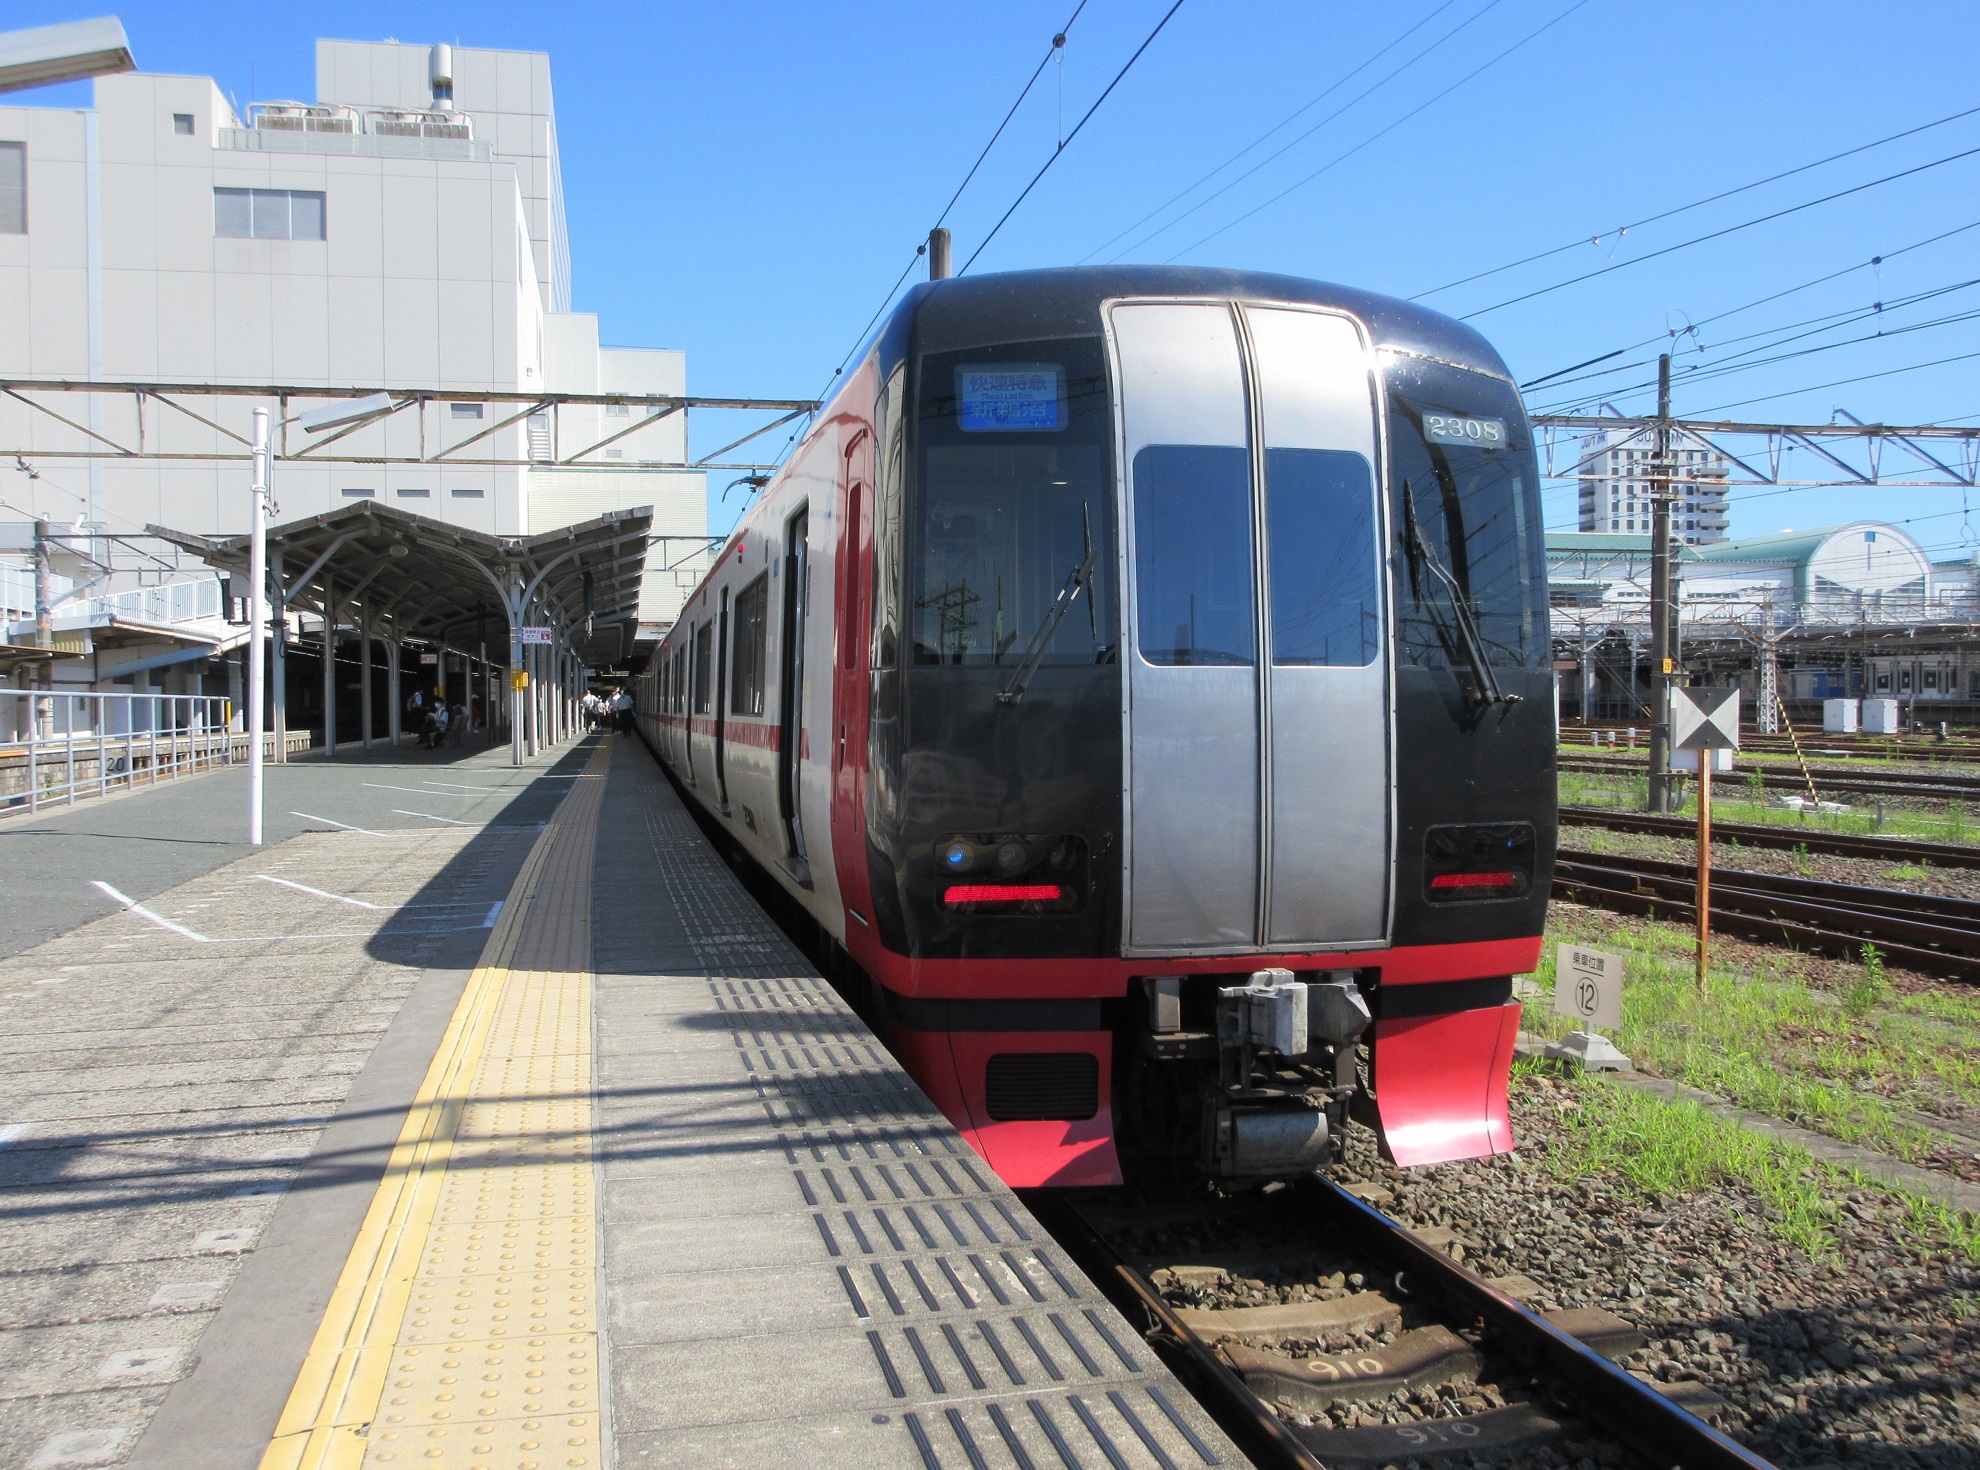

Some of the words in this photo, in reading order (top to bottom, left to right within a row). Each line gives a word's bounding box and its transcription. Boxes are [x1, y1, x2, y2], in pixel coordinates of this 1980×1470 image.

[970, 375, 1047, 391] 快速特急
[1429, 416, 1499, 441] 2308
[106, 757, 125, 772] 20
